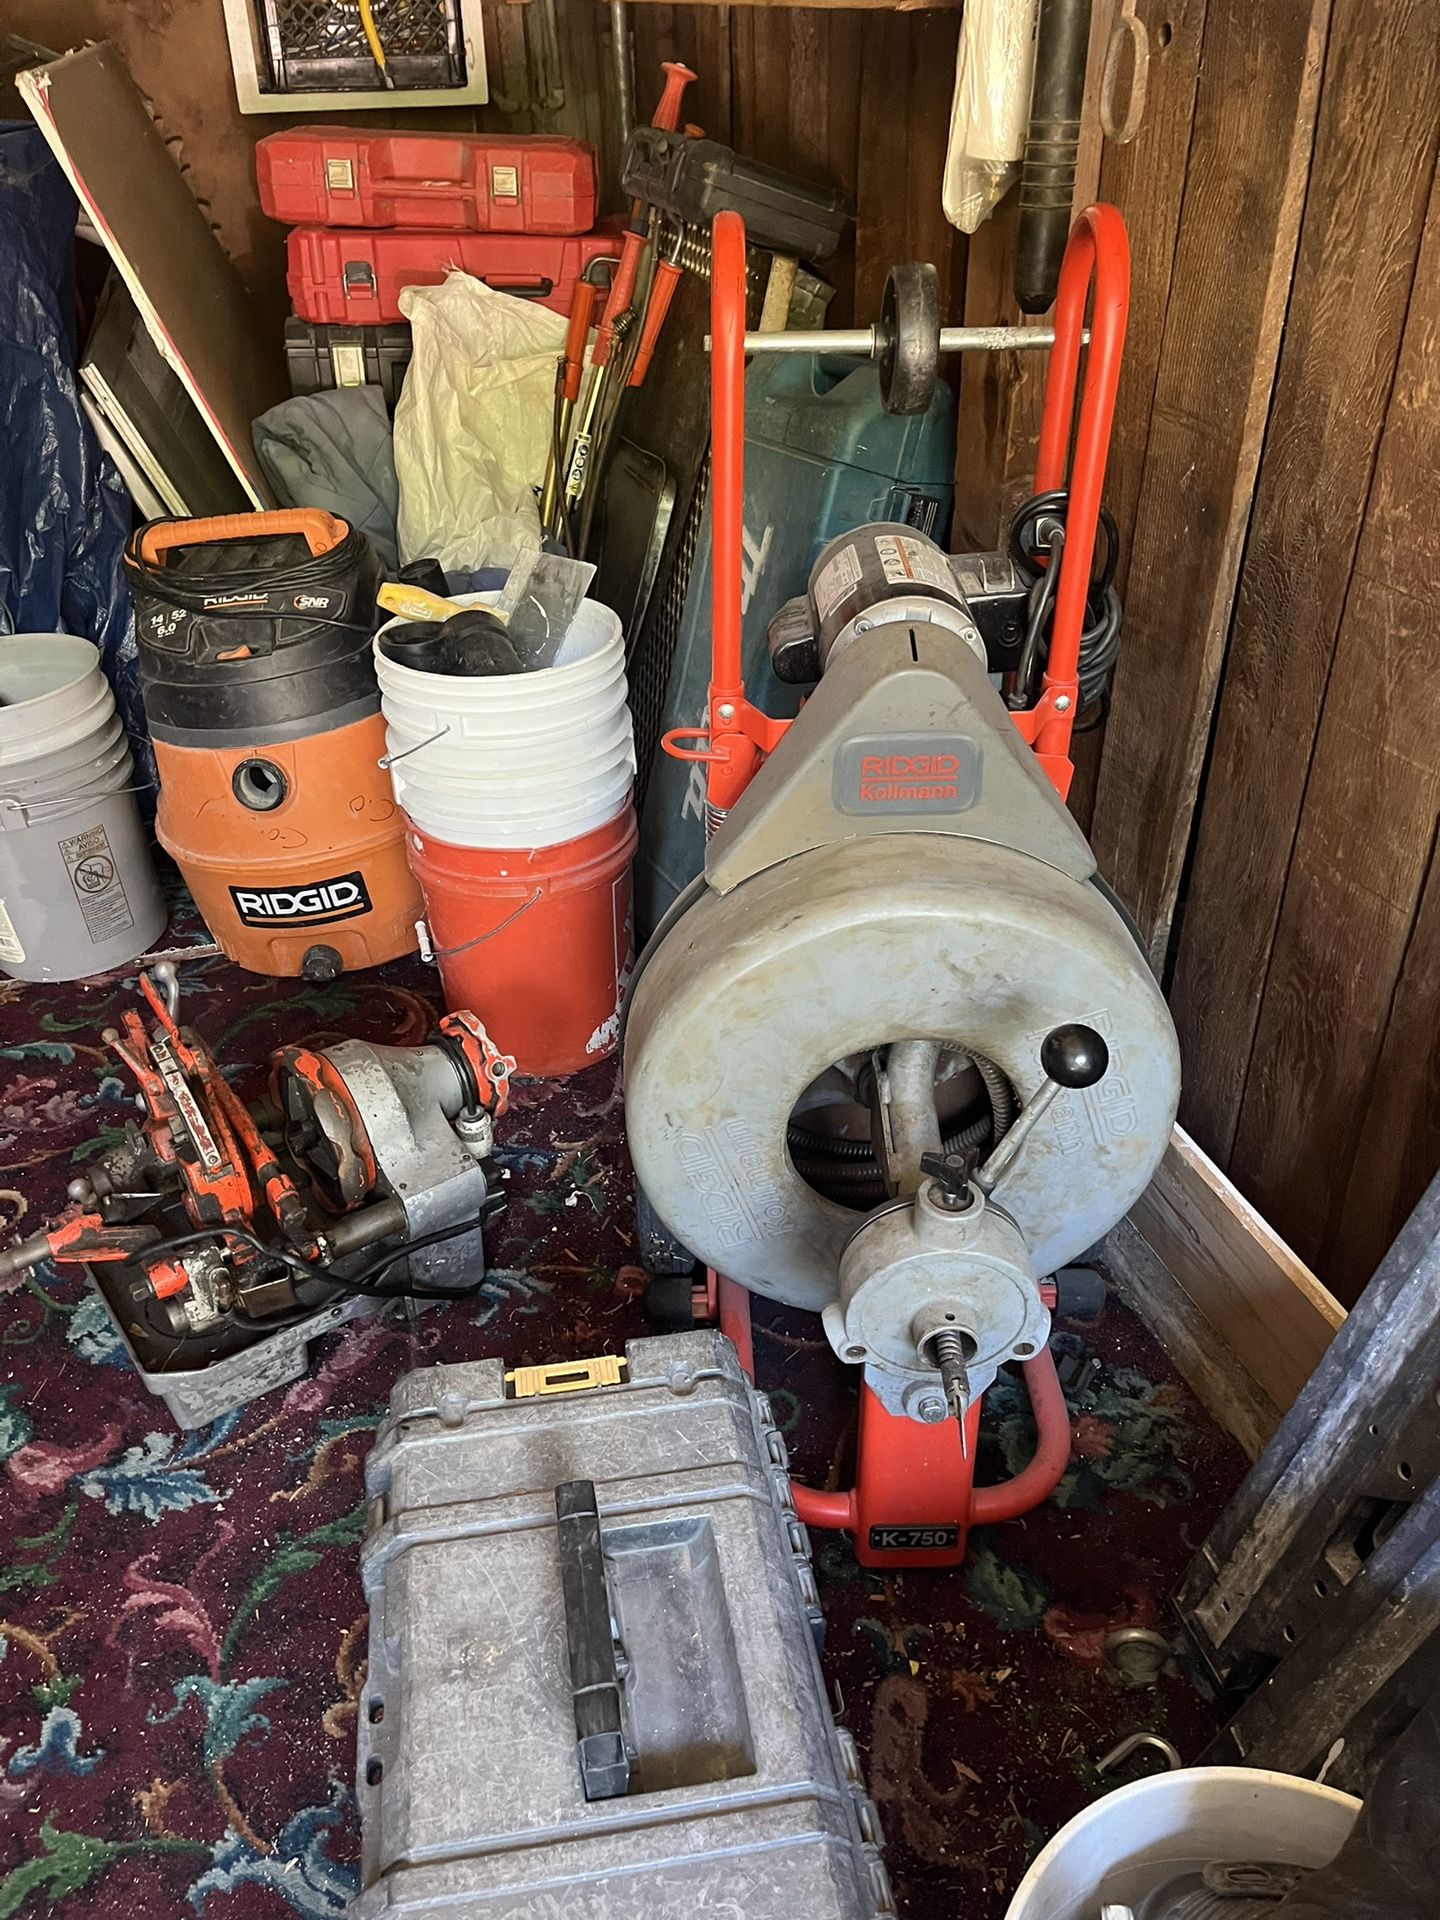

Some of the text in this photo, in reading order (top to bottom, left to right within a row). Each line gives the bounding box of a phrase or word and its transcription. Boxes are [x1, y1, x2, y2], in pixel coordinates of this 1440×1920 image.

[299, 597, 330, 609] SNR
[151, 609, 187, 625] 14 52
[157, 622, 176, 635] 6.0
[862, 755, 960, 775] RIDGID
[860, 784, 957, 801] Kollmann
[236, 882, 360, 915] RIDGID
[725, 1117, 795, 1238] Kollmann
[673, 1133, 753, 1249] RIDGID
[882, 1532, 947, 1546] K-750
